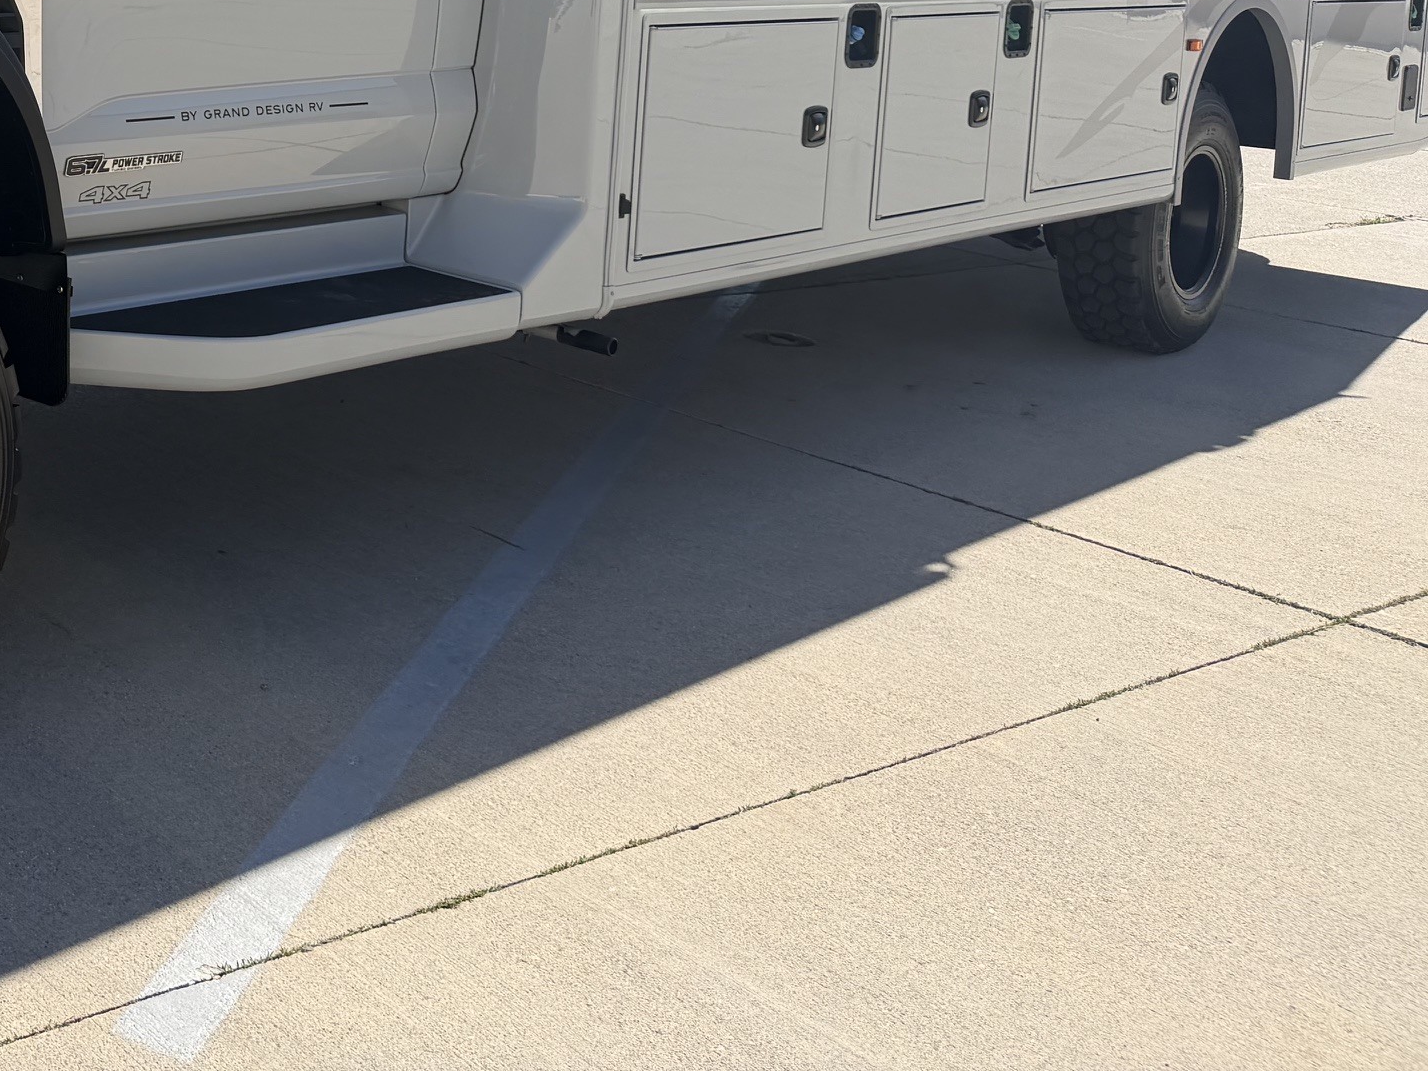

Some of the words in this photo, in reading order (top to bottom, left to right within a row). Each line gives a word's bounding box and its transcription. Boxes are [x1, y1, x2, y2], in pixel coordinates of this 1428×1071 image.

[181, 111, 198, 122] BY
[203, 107, 250, 120] GRAND
[256, 103, 304, 116] DESIGN
[309, 102, 324, 112] RV
[65, 155, 110, 176] 6.7L
[112, 157, 144, 168] POWER
[145, 152, 182, 165] STROKE
